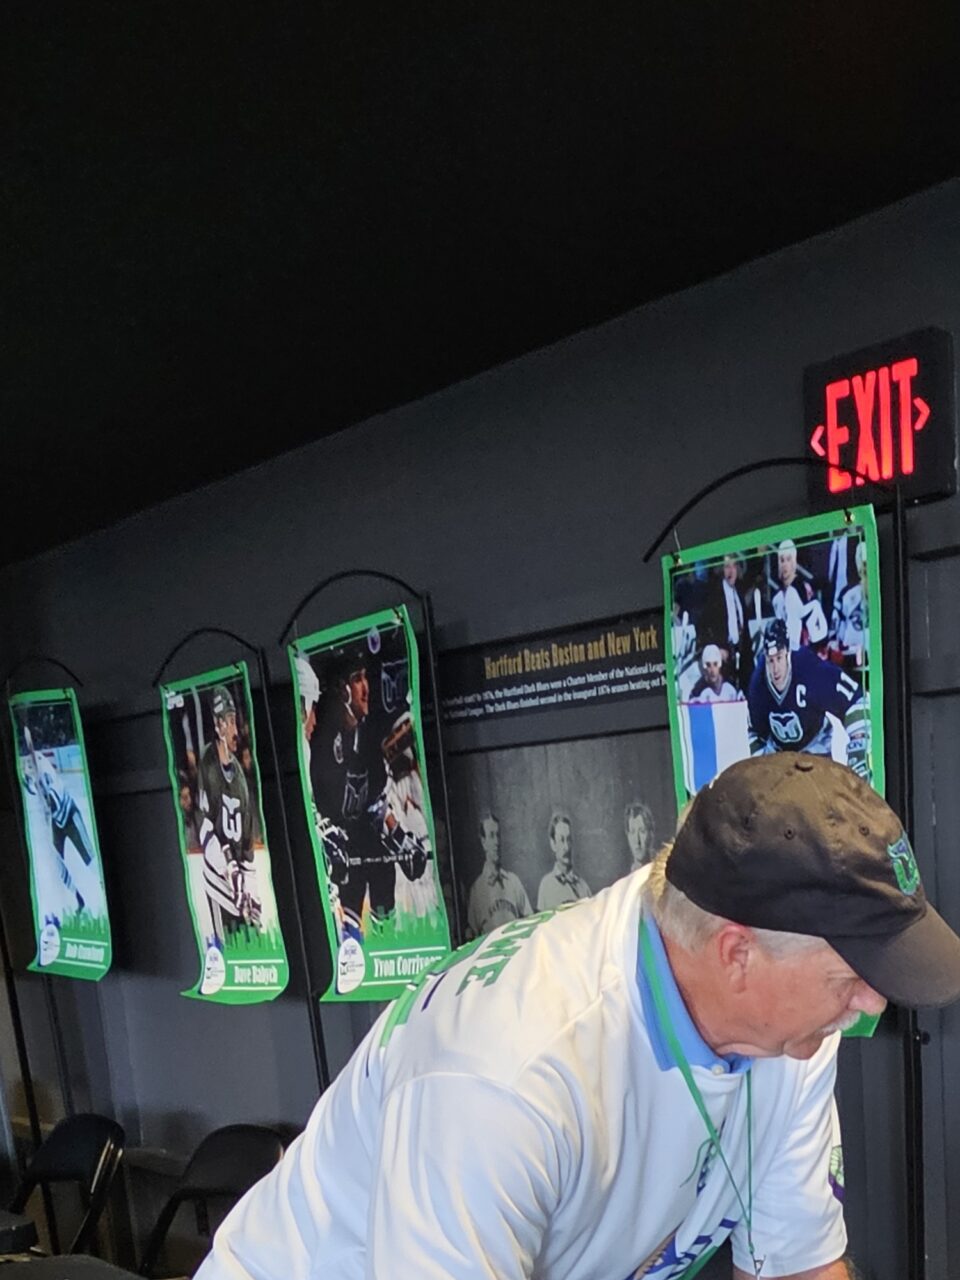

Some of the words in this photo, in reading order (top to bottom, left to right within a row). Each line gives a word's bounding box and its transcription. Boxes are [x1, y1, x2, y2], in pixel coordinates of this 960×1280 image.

[825, 357, 918, 494] EXIT
[484, 650, 523, 680] Hartford
[523, 648, 550, 673] Beats
[551, 642, 586, 668] Boston
[587, 634, 605, 661] and
[607, 631, 631, 657] New
[633, 625, 658, 652] York
[374, 957, 395, 978] Yvon
